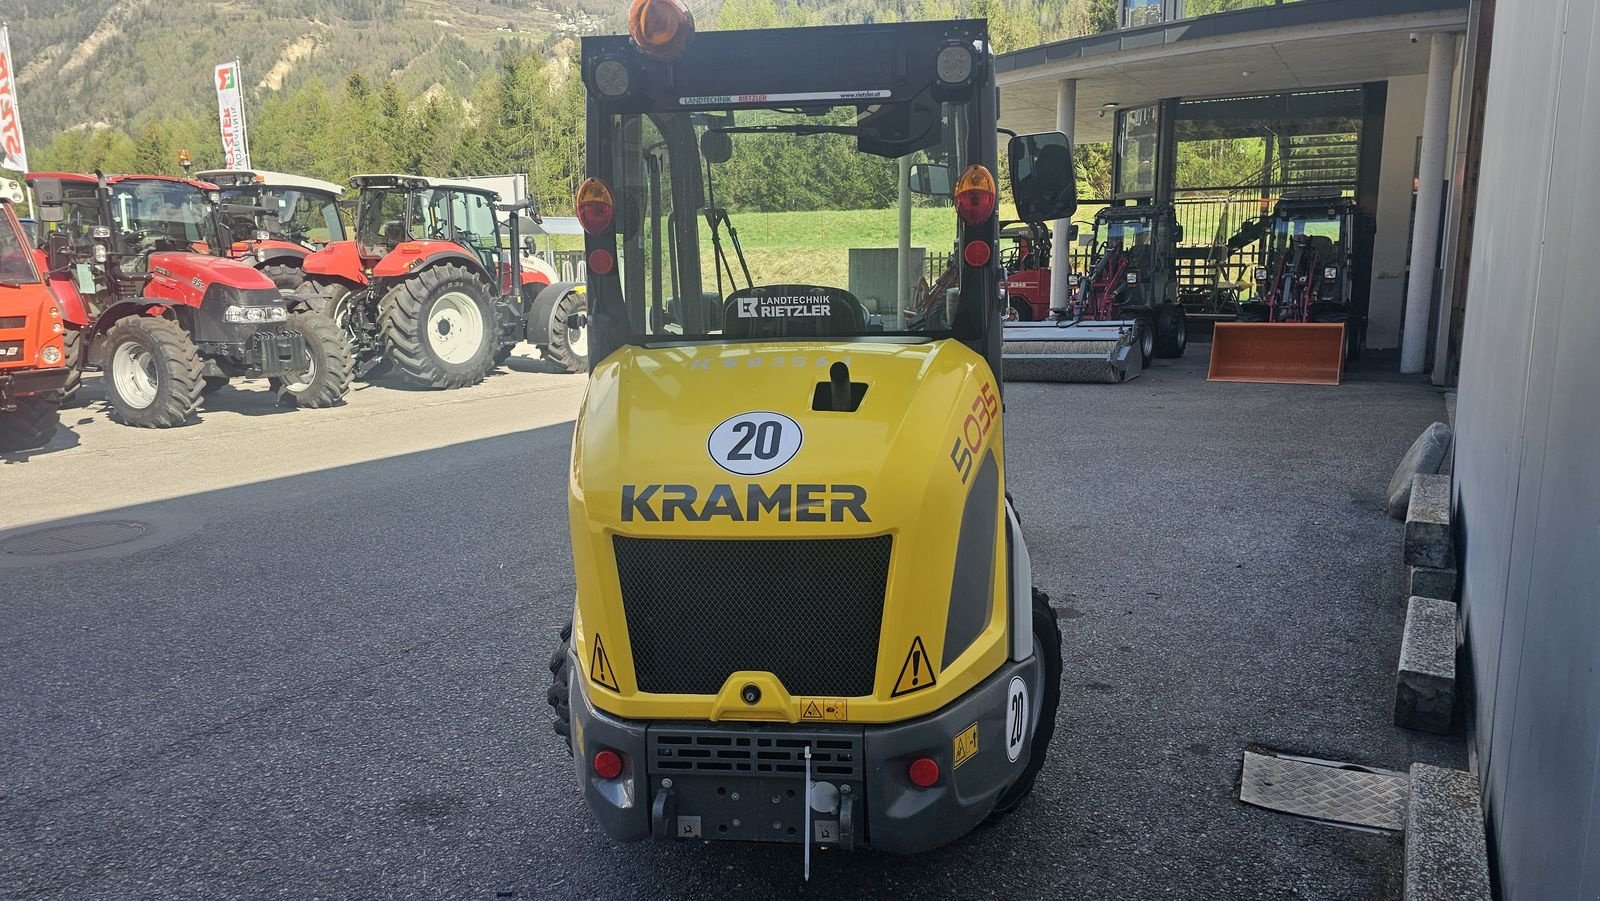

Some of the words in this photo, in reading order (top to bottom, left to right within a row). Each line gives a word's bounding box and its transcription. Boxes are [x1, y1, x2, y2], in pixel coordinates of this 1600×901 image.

[684, 96, 732, 104] LANDTECHNIK
[760, 296, 830, 305] LANDTECHNIK
[760, 305, 831, 317] RIETZLER
[726, 420, 783, 461] 20
[951, 382, 999, 485] 5035
[620, 483, 873, 523] KRAMER
[1010, 691, 1023, 748] 20
